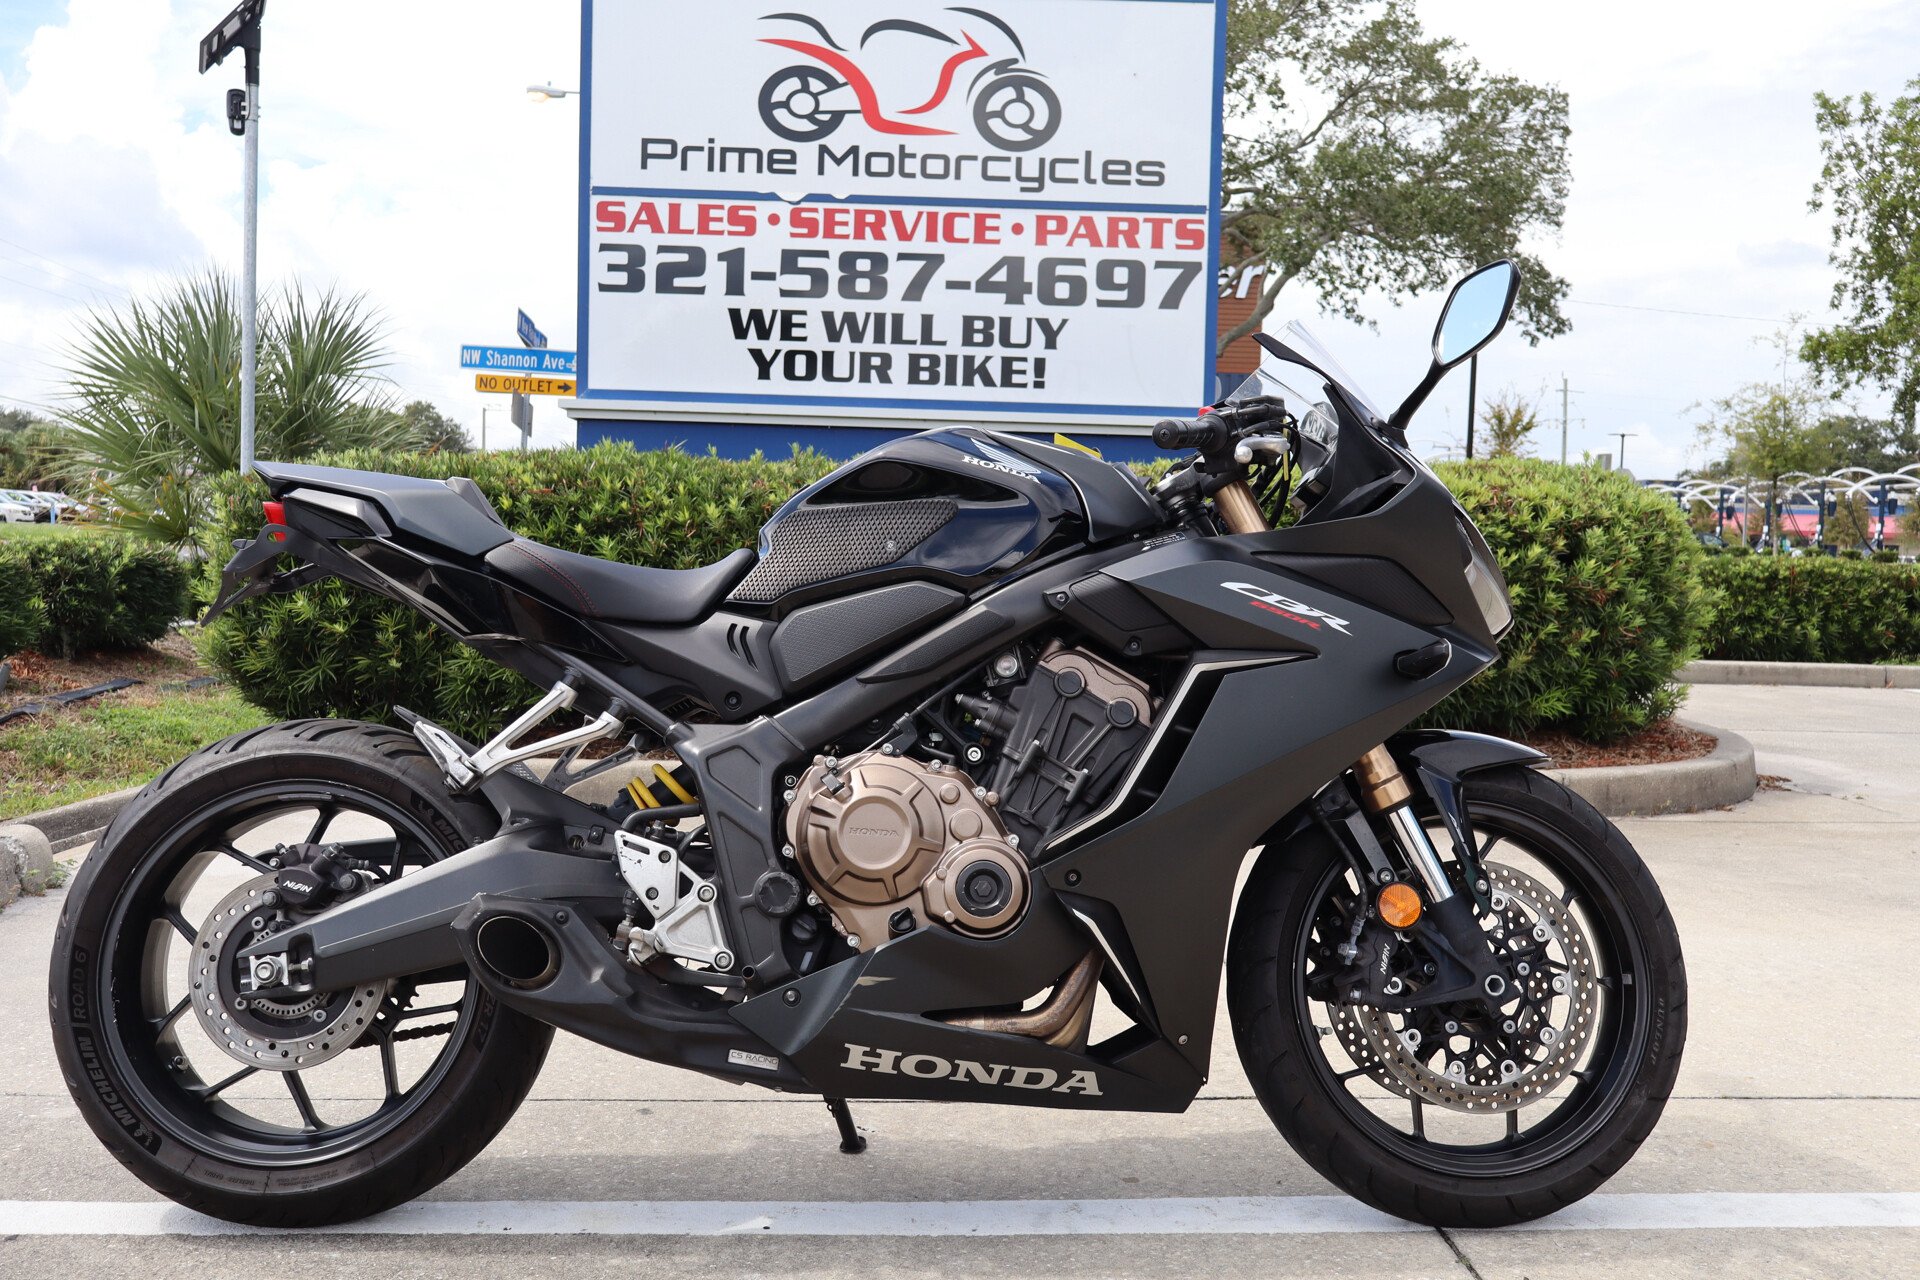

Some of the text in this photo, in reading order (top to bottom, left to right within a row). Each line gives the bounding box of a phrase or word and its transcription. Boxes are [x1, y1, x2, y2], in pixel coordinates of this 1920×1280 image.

[641, 138, 1165, 192] Prime Motorcycles
[596, 201, 1205, 250] SALES SERVICE PARTS
[598, 243, 1203, 310] 321-587-4697
[728, 308, 1069, 350] WE WILL BUY
[463, 349, 565, 370] NW Shannon Ave
[747, 348, 1046, 389] YOUR BIKE!
[479, 377, 552, 393] NO OUTLET
[962, 455, 1041, 484] HONDA
[1220, 582, 1353, 636] CBR
[849, 826, 901, 840] HONDA
[72, 951, 87, 1020] ROAD 6
[746, 1053, 778, 1065] RACING
[840, 1043, 1103, 1096] HONDA
[78, 1035, 136, 1132] MICHELIN
